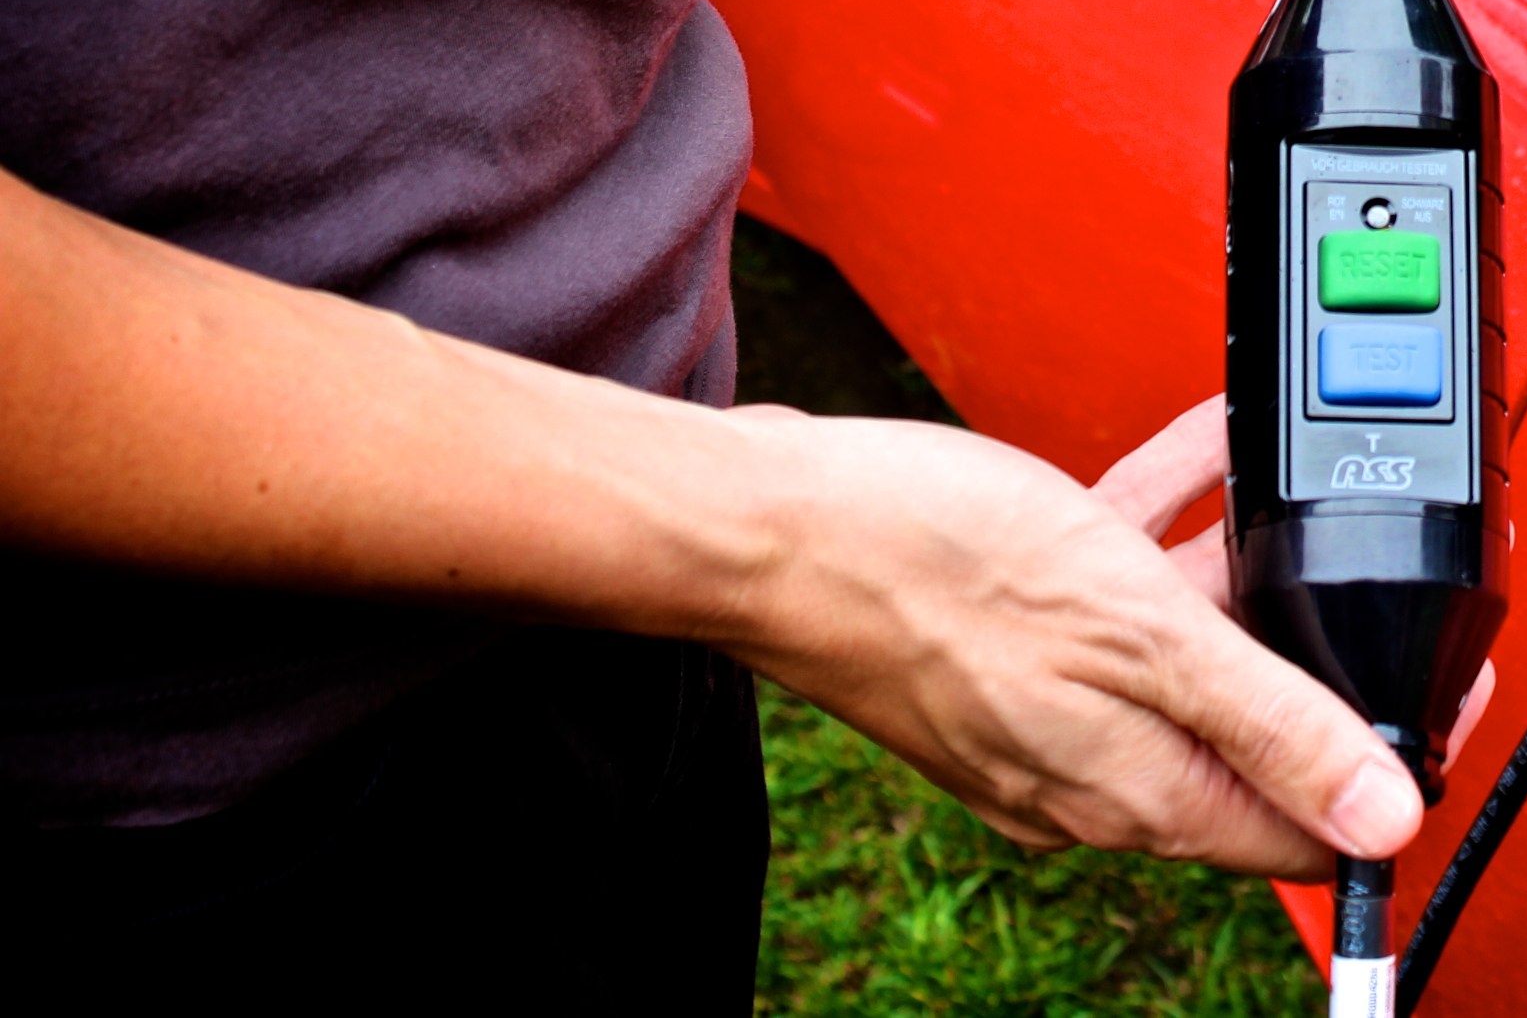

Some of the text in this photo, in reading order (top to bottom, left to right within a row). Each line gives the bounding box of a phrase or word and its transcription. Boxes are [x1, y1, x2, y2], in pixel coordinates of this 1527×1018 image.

[1337, 160, 1400, 174] GEBRAUCH
[1327, 195, 1346, 208] ROT
[1401, 196, 1445, 211] SCHWARZ
[1413, 211, 1432, 223] AUS
[1338, 249, 1427, 281] RESET
[1350, 342, 1418, 373] TEST
